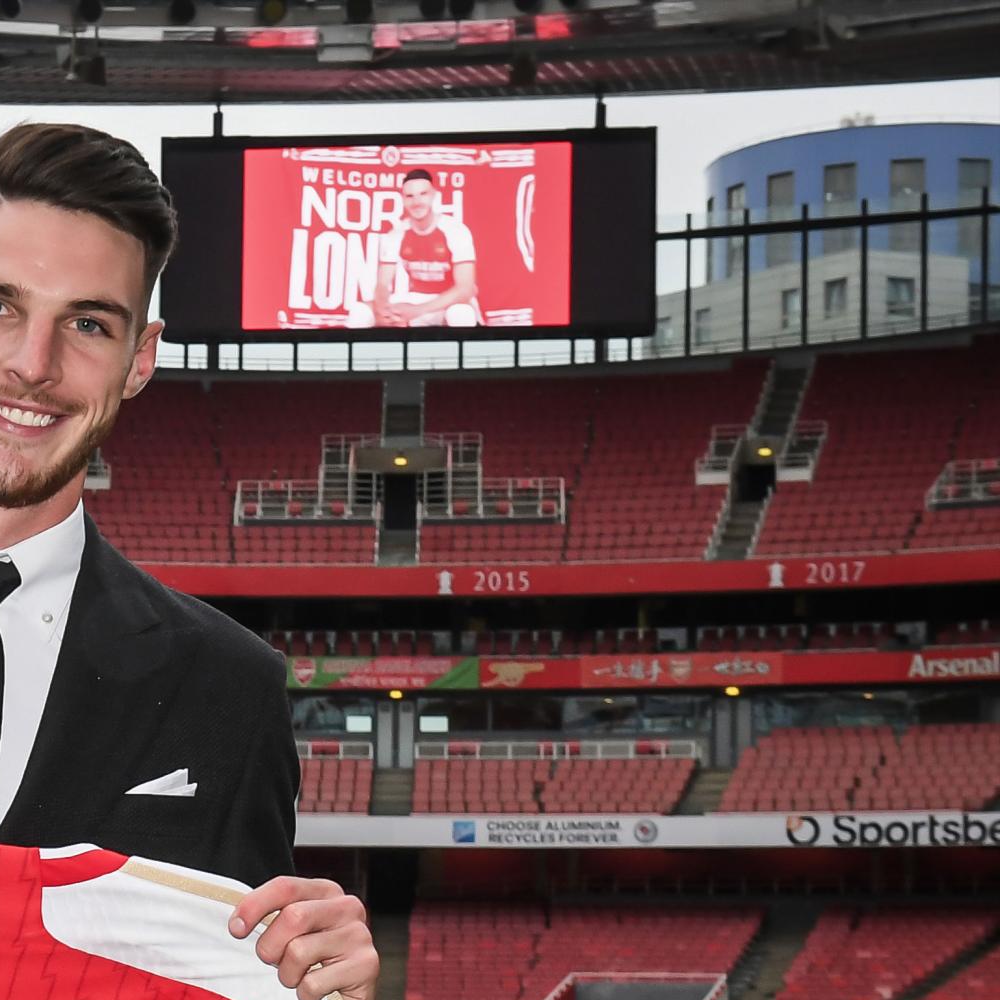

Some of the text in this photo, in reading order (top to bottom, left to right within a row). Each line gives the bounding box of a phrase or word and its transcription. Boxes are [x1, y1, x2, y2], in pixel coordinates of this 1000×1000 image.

[437, 171, 465, 188] TO
[301, 185, 463, 232] NORH
[473, 570, 530, 592] 2015
[805, 560, 866, 584] 2017
[908, 651, 1000, 677] Arsenal
[486, 820, 540, 831] CHOOSE
[488, 832, 555, 843] RECYCLES
